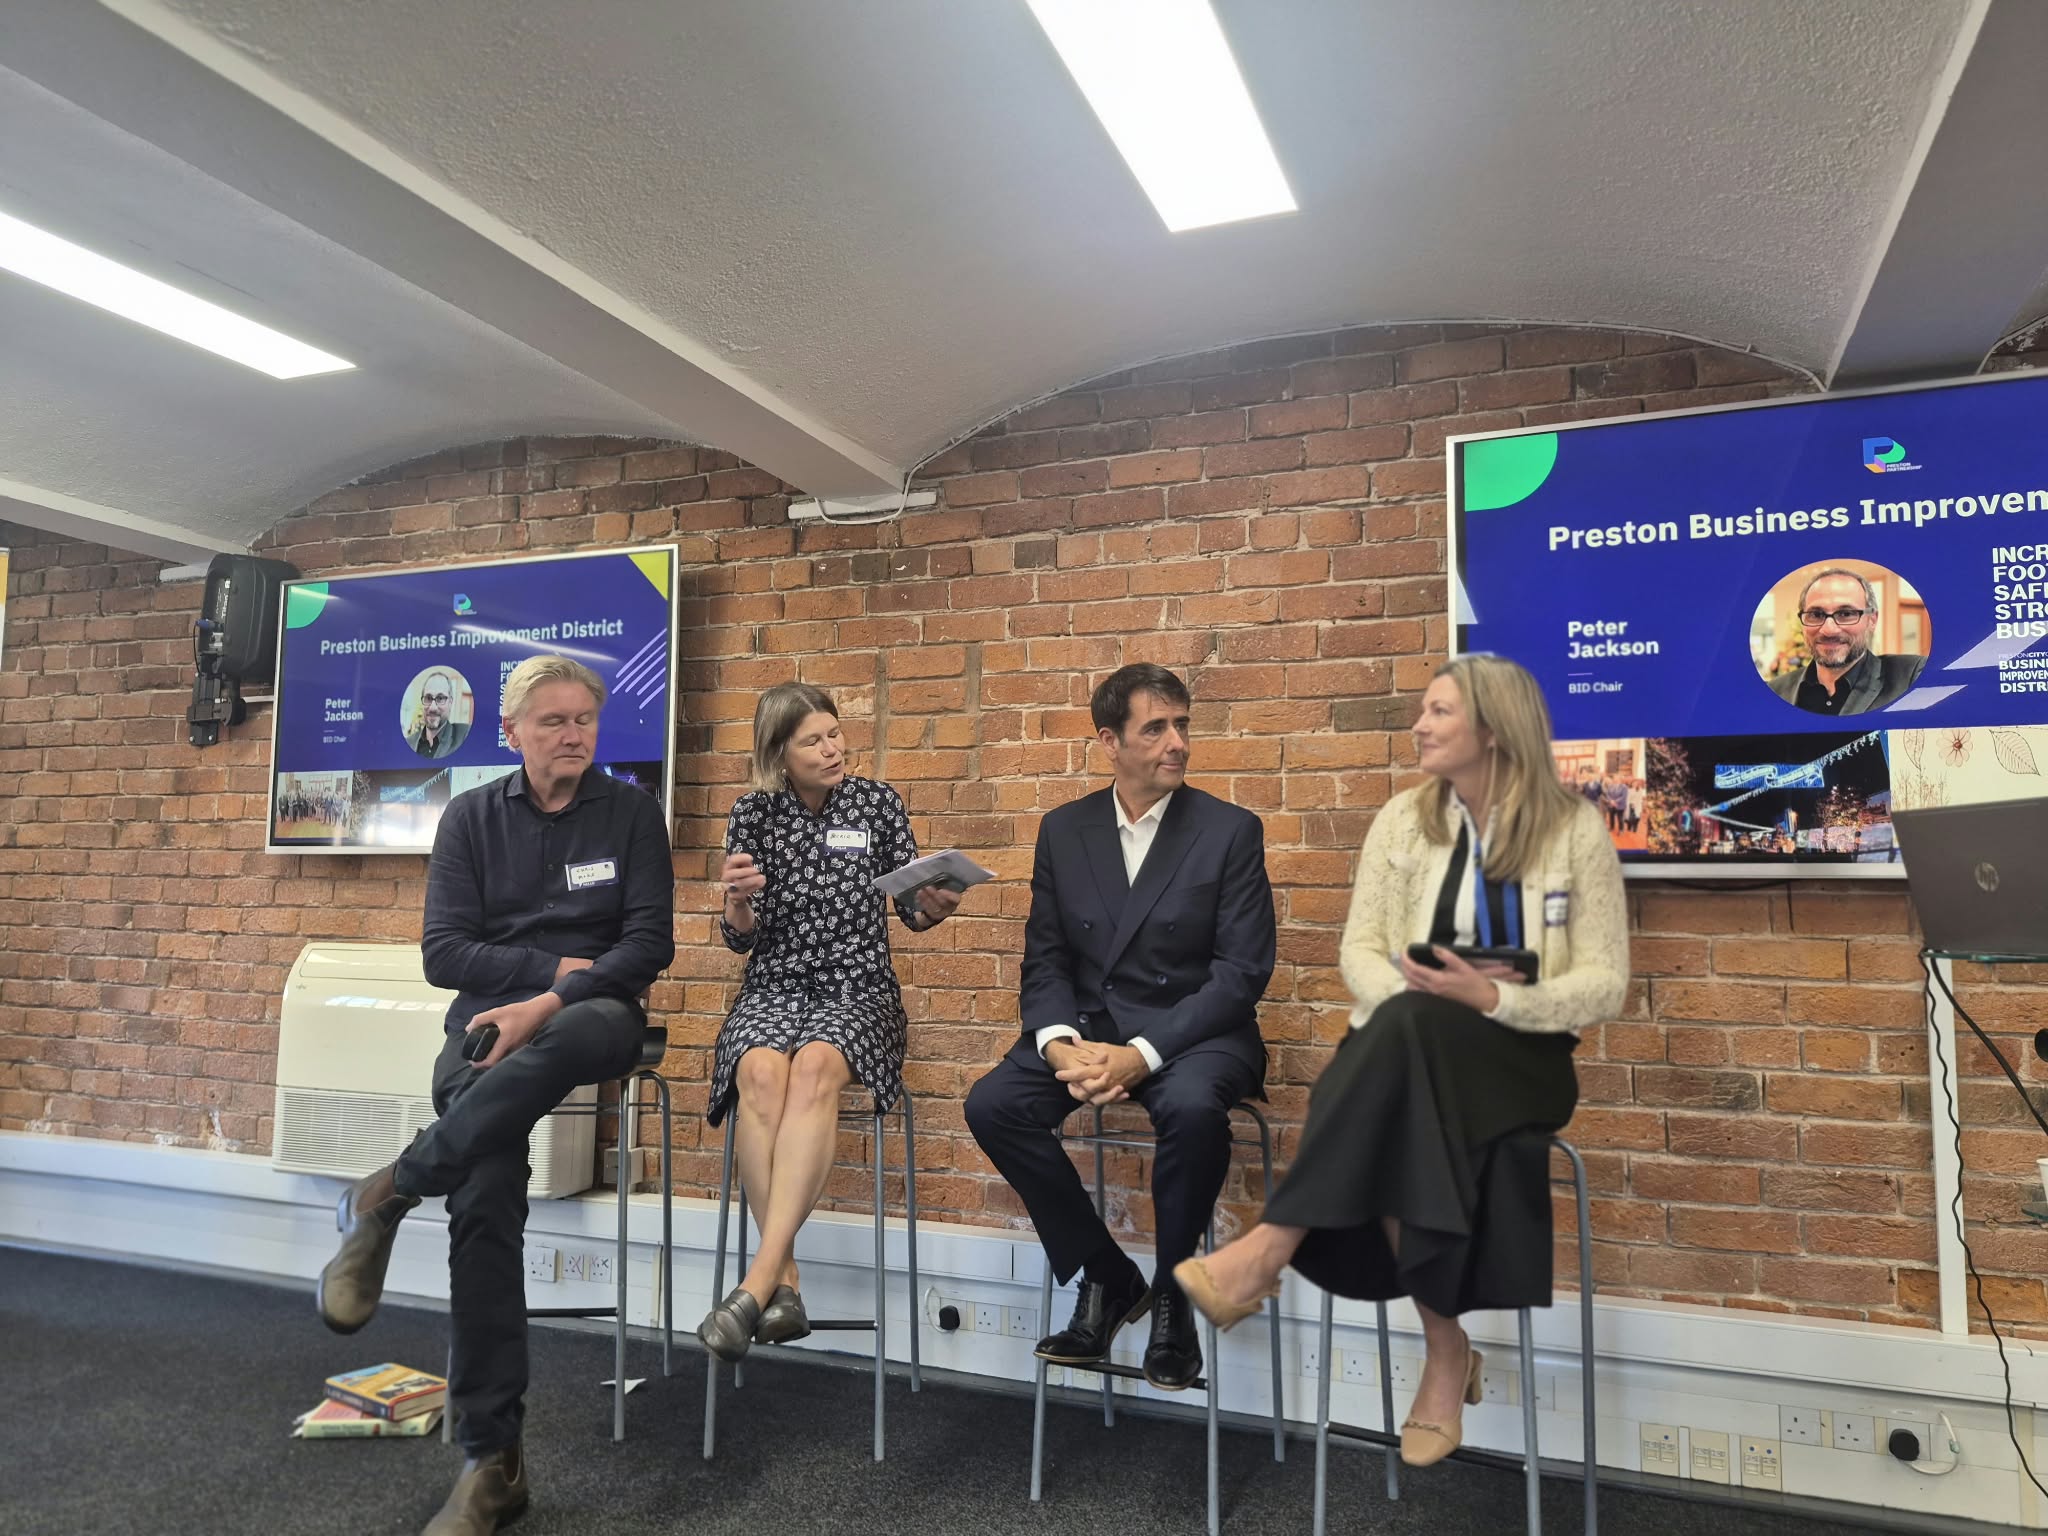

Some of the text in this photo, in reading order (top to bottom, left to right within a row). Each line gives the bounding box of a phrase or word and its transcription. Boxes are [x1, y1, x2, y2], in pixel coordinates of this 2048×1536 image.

[1549, 521, 1679, 551] Preston
[1689, 507, 1850, 539] Business
[1993, 563, 2048, 583] FOO
[1994, 582, 2048, 602] SAF
[1994, 601, 2048, 621] STR
[320, 618, 623, 656] Preston Business Improvement District
[1567, 620, 1628, 638] Peter
[1567, 639, 1660, 659] Jackson
[1999, 659, 2048, 670] BUSIN
[1568, 681, 1623, 694] BID Chair
[2000, 681, 2048, 694] DISTR
[325, 698, 352, 709] Peter
[324, 710, 364, 722] Jackson
